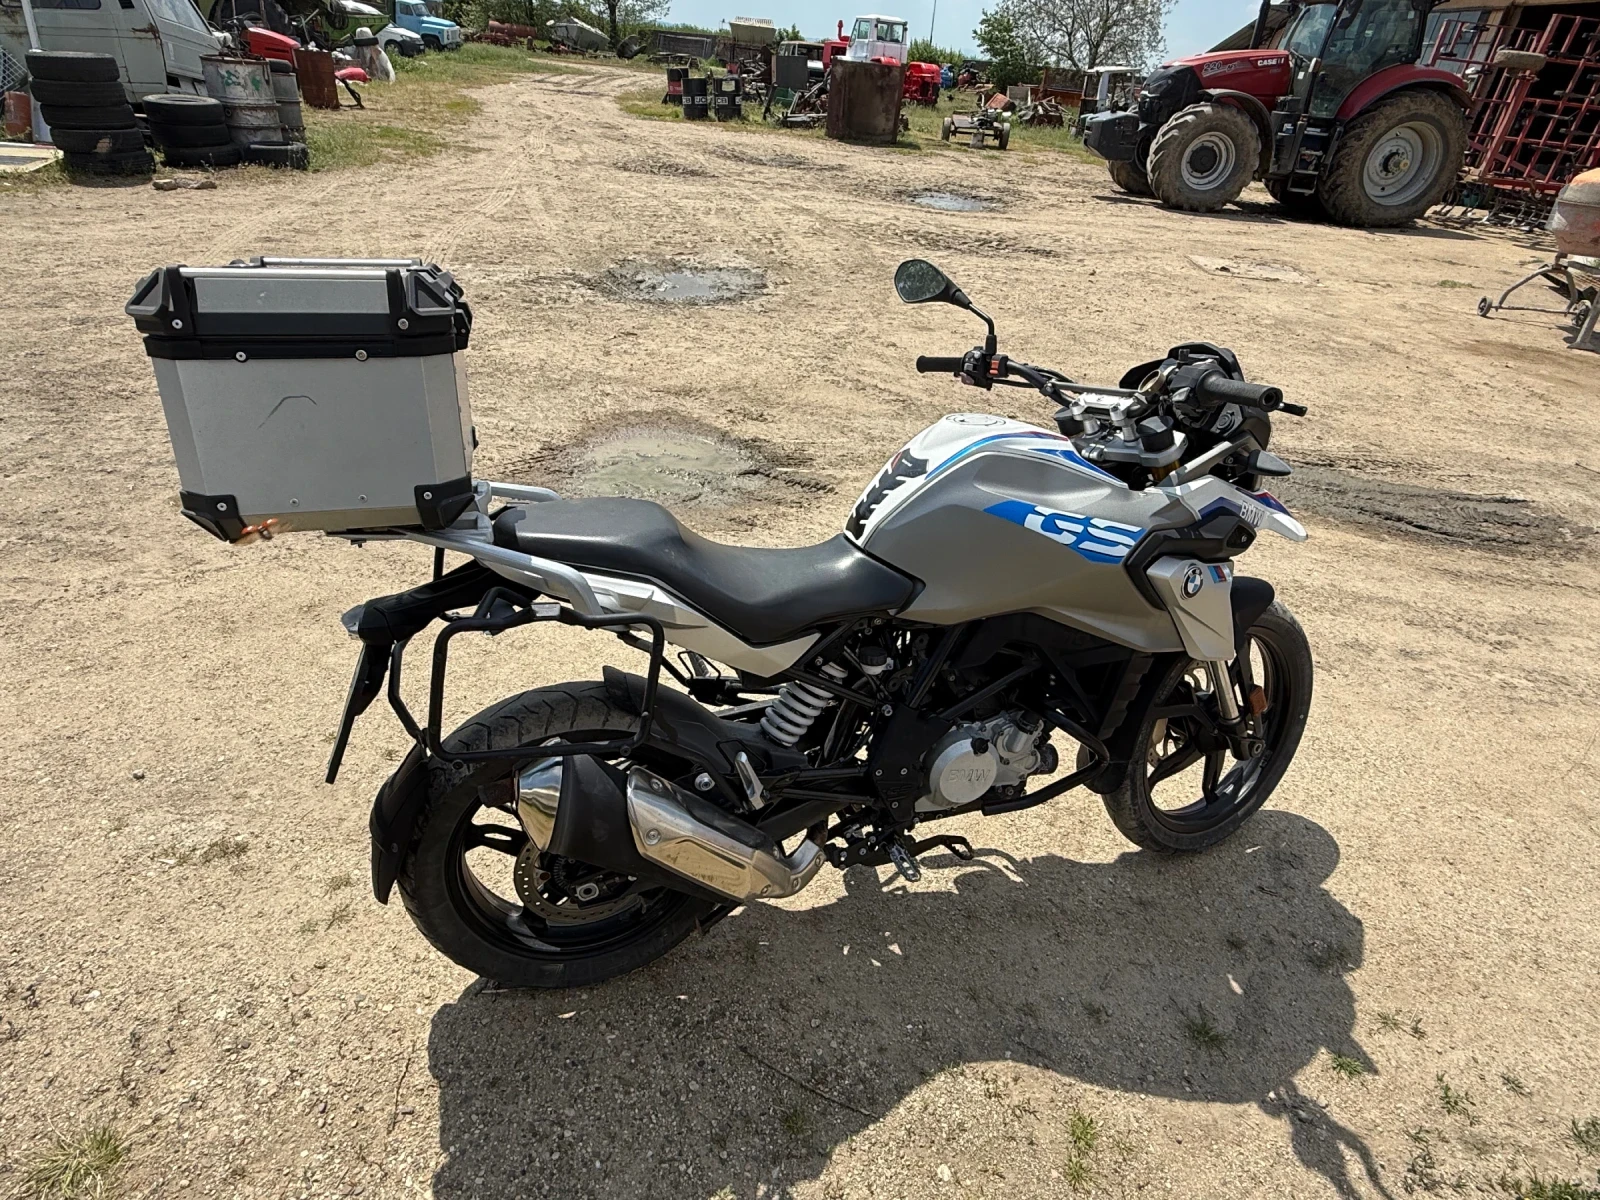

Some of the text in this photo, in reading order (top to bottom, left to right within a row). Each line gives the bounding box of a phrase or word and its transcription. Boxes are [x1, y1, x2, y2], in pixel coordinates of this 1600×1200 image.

[1203, 61, 1222, 72] 220
[1240, 501, 1265, 527] BMW
[1024, 505, 1142, 557] GS
[948, 768, 991, 783] BMW
